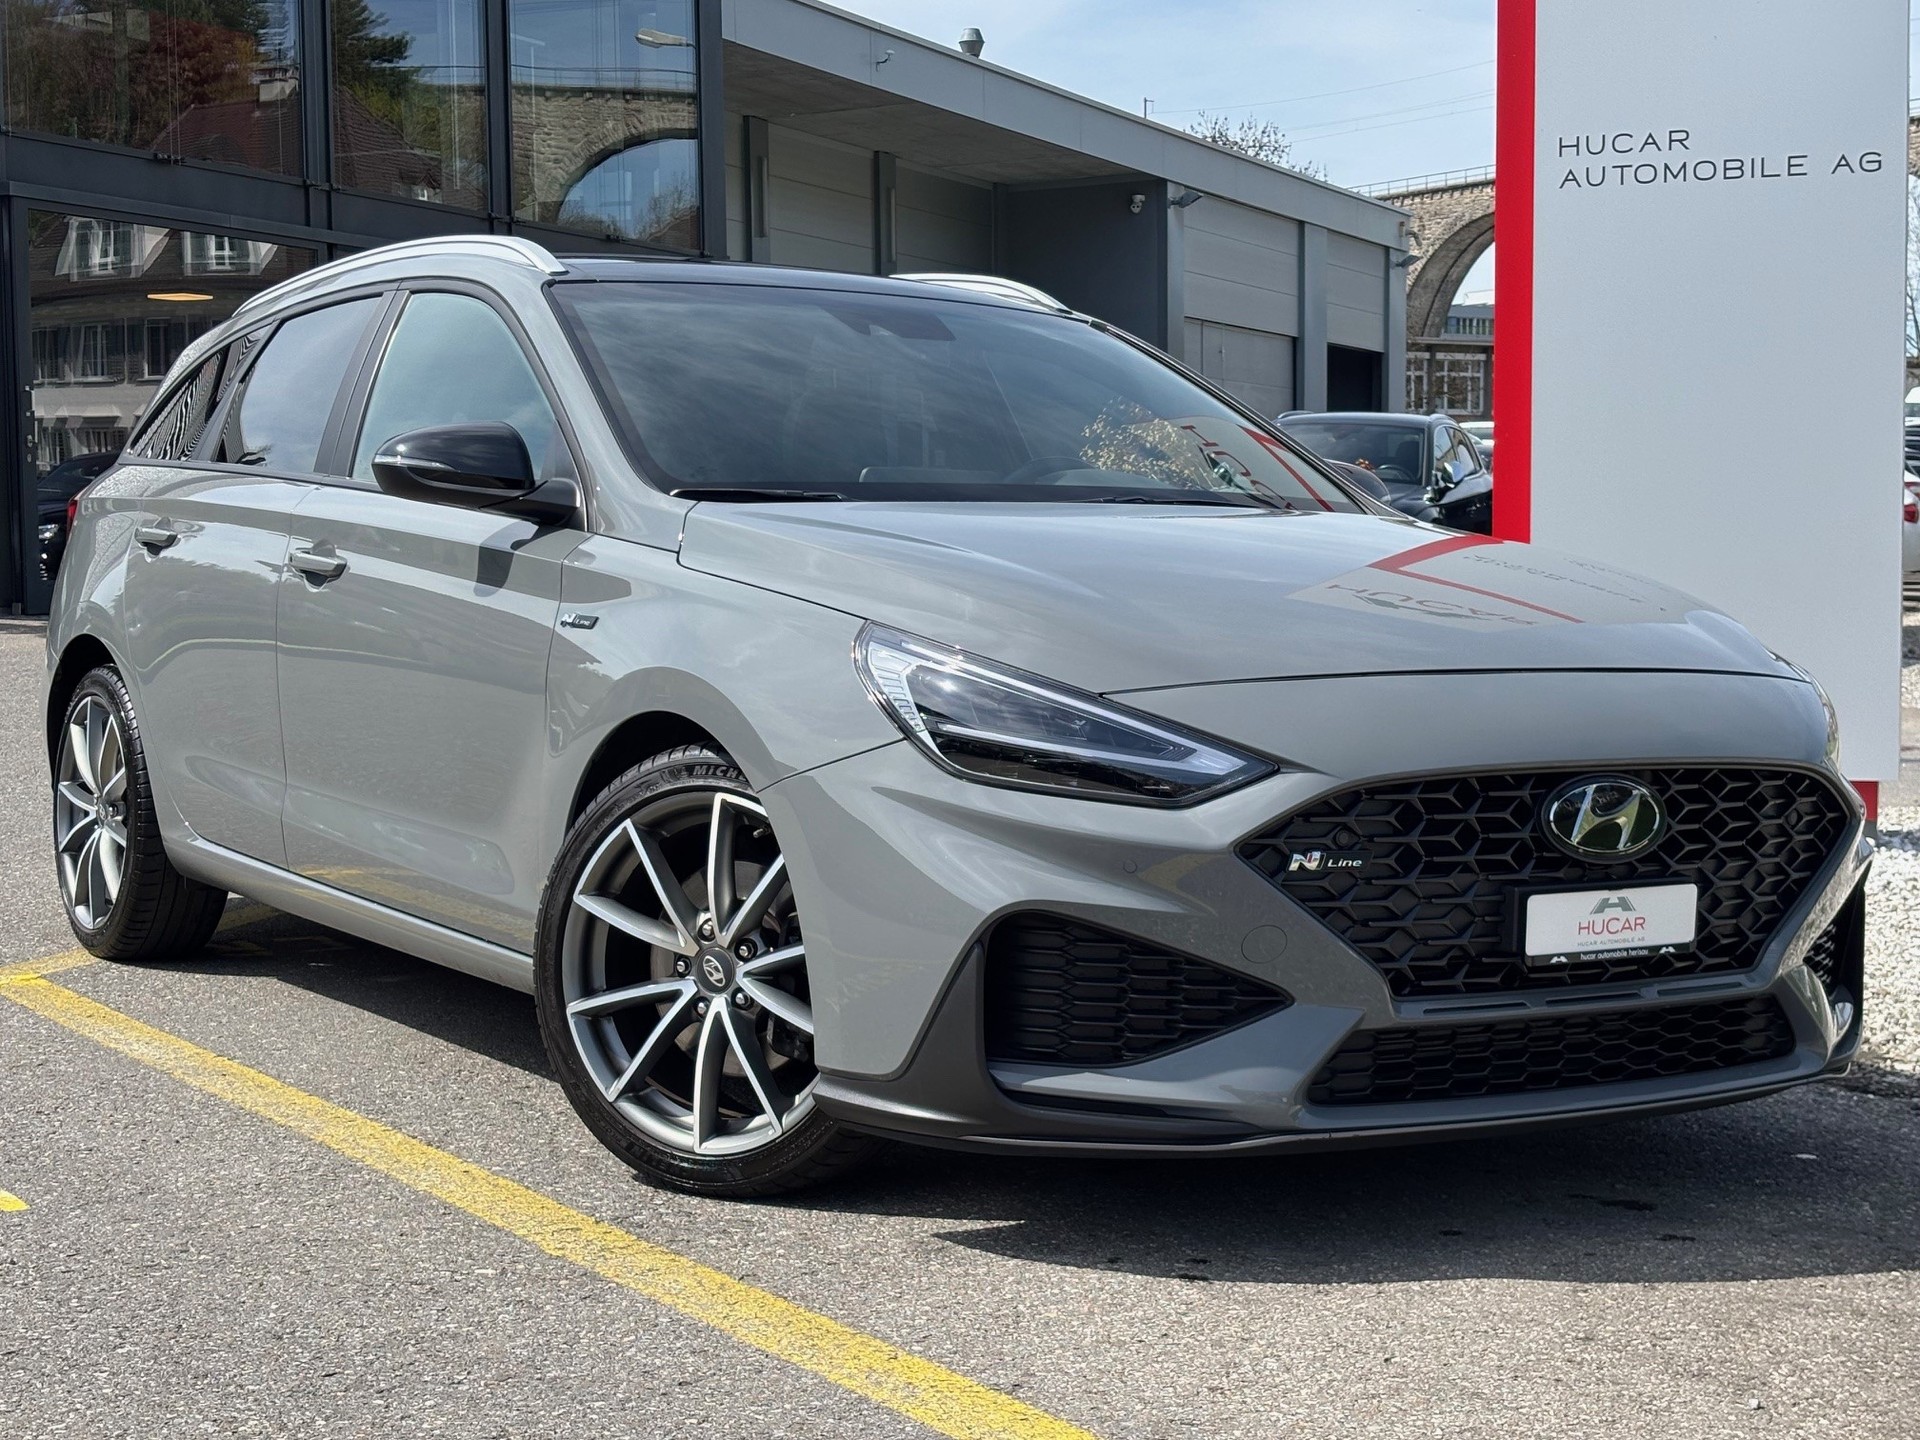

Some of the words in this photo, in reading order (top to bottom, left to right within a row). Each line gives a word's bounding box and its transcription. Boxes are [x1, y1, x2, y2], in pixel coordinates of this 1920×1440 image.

[1558, 129, 1690, 158] HUCAR
[1558, 155, 1809, 190] AUTOMOBILE
[1831, 151, 1883, 175] AG
[1288, 851, 1322, 871] N
[1327, 858, 1363, 868] Line
[1577, 916, 1646, 936] HUCAR
[1577, 940, 1598, 948] HUCAR
[1600, 937, 1635, 946] AUTOMOBILE
[1580, 952, 1596, 961] hucar
[1597, 949, 1628, 960] automobile
